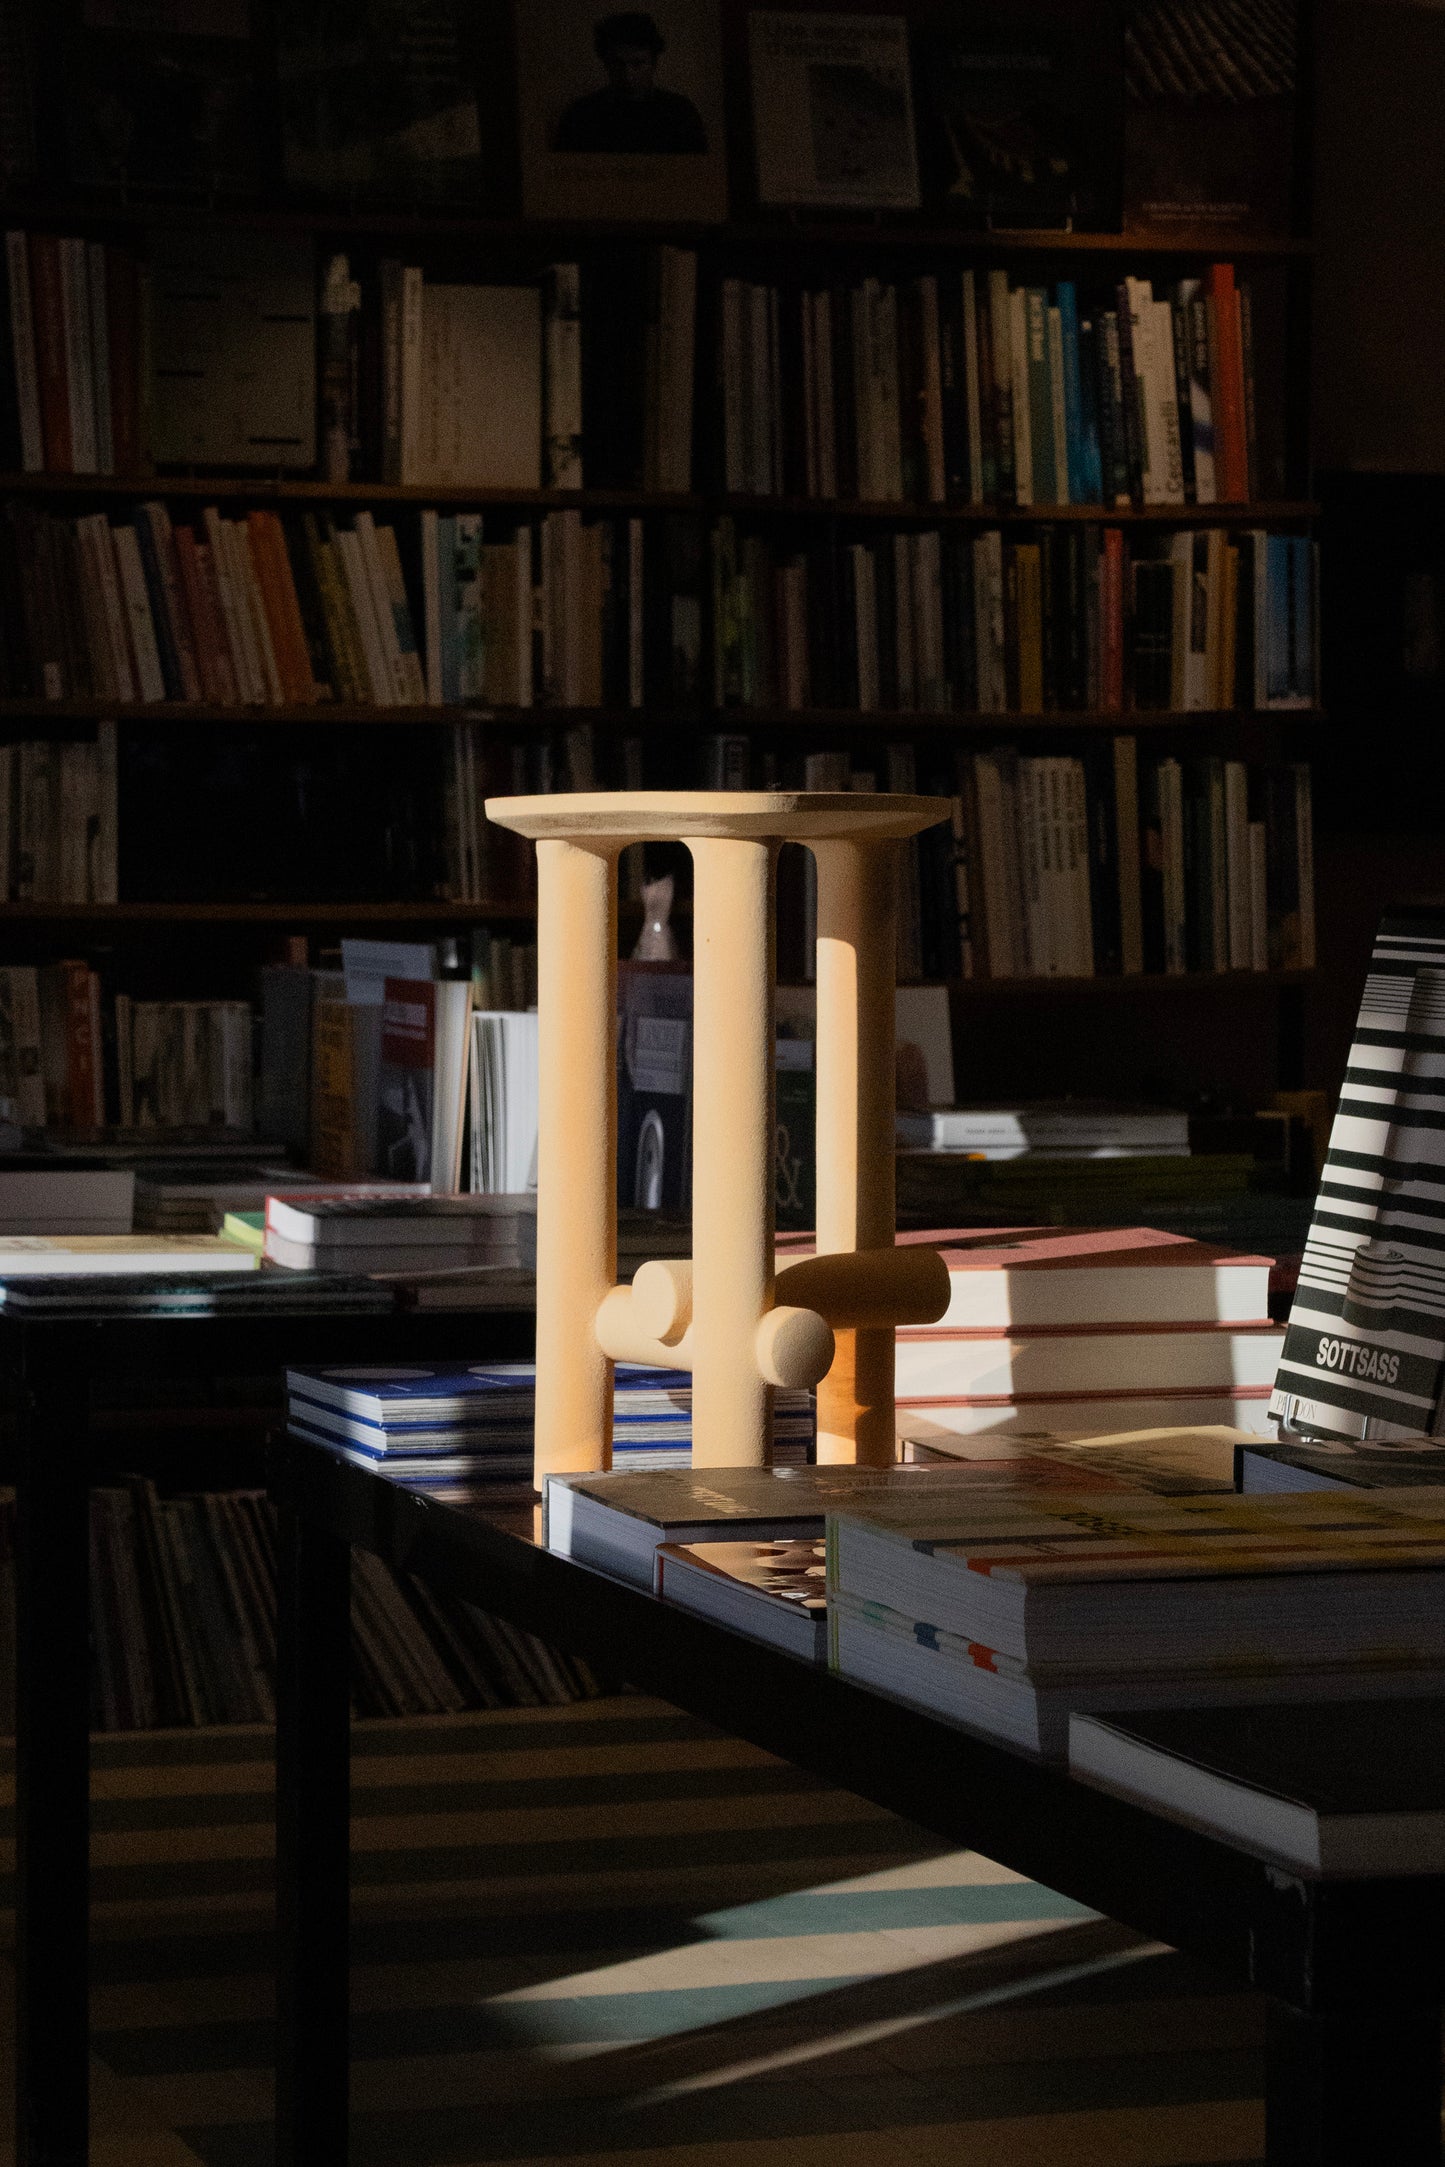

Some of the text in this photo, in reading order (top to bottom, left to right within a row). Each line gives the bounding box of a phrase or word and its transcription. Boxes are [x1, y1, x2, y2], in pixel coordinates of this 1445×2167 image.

[1161, 401, 1181, 493] Ceccarelli
[1316, 1337, 1400, 1384] SOTTSASS
[1276, 1394, 1318, 1420] PHIDON
